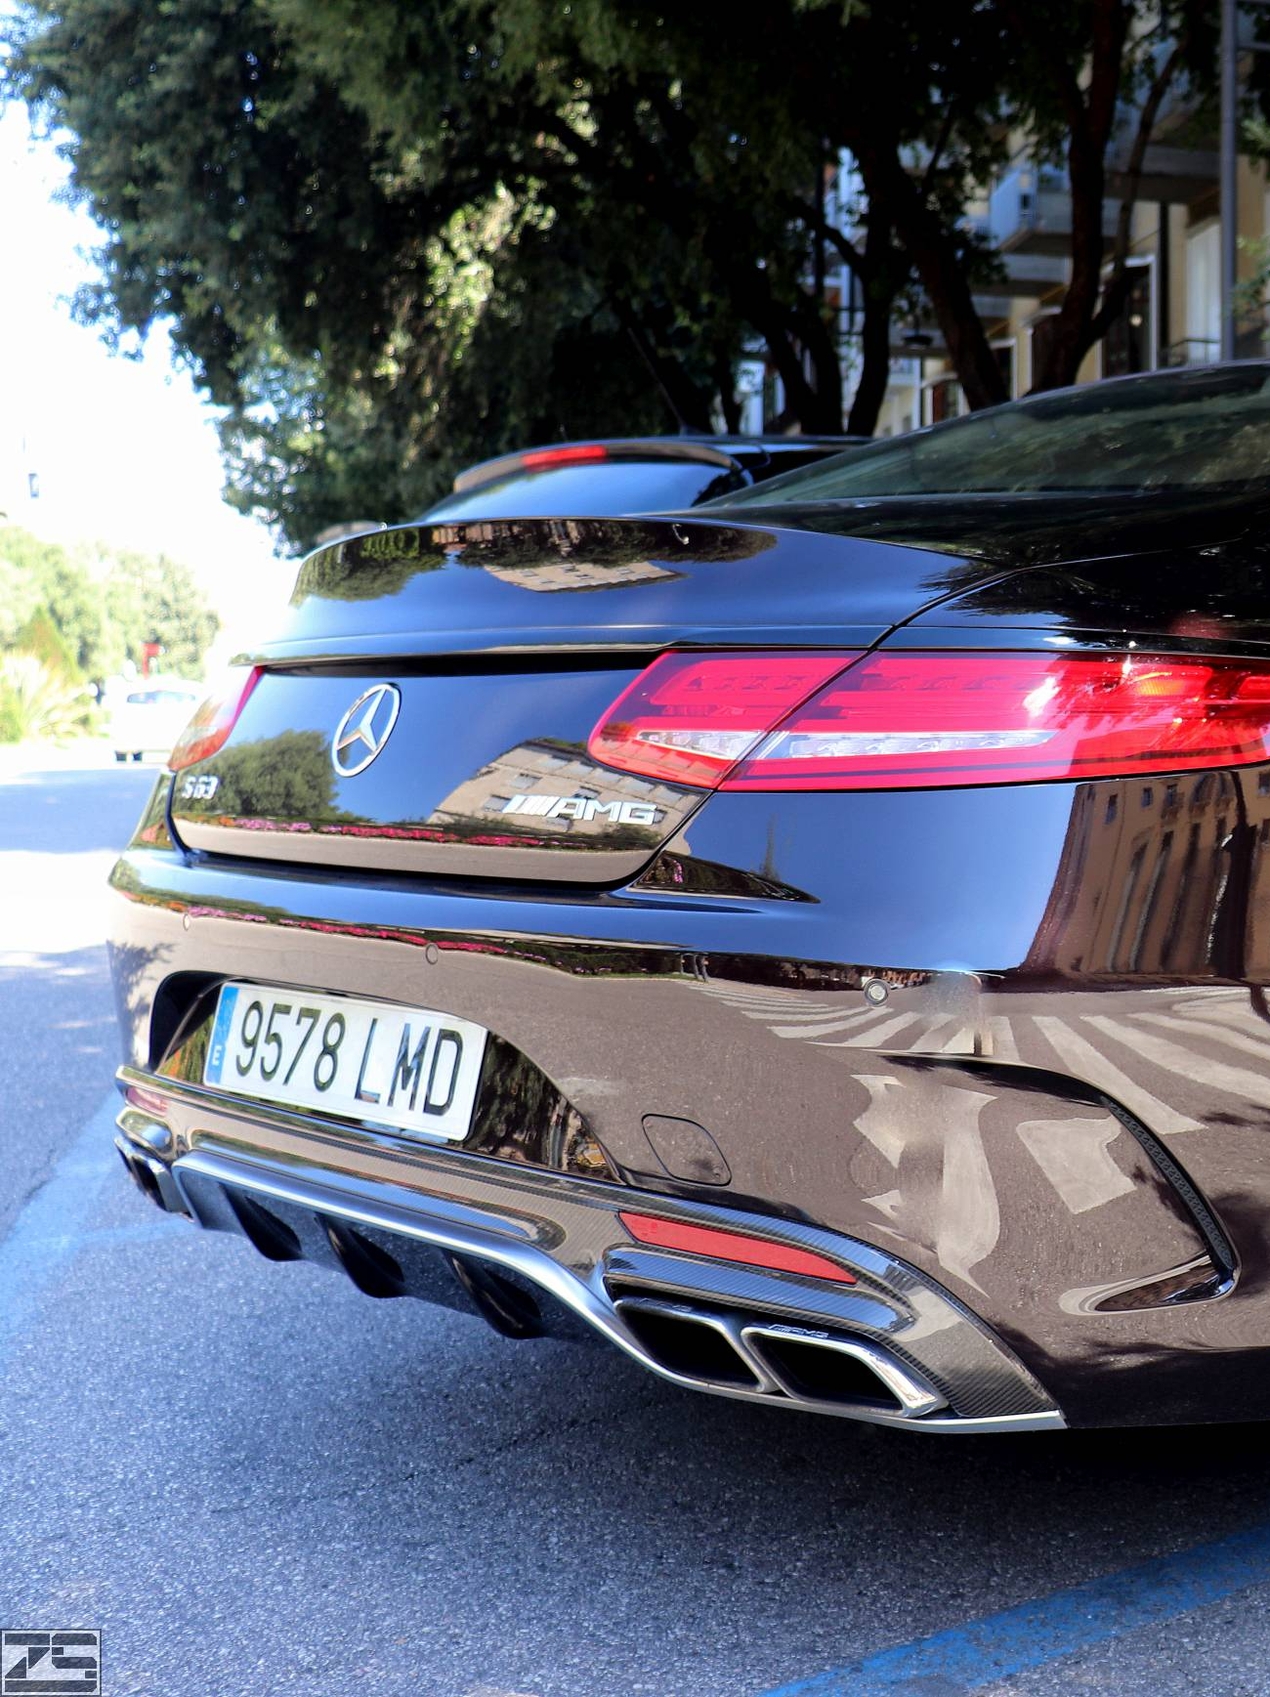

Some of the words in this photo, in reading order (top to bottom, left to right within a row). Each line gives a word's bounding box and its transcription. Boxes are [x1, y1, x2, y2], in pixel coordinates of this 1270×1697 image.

[210, 1046, 222, 1066] E
[235, 1000, 346, 1093] 9578
[354, 1018, 464, 1116] LMD
